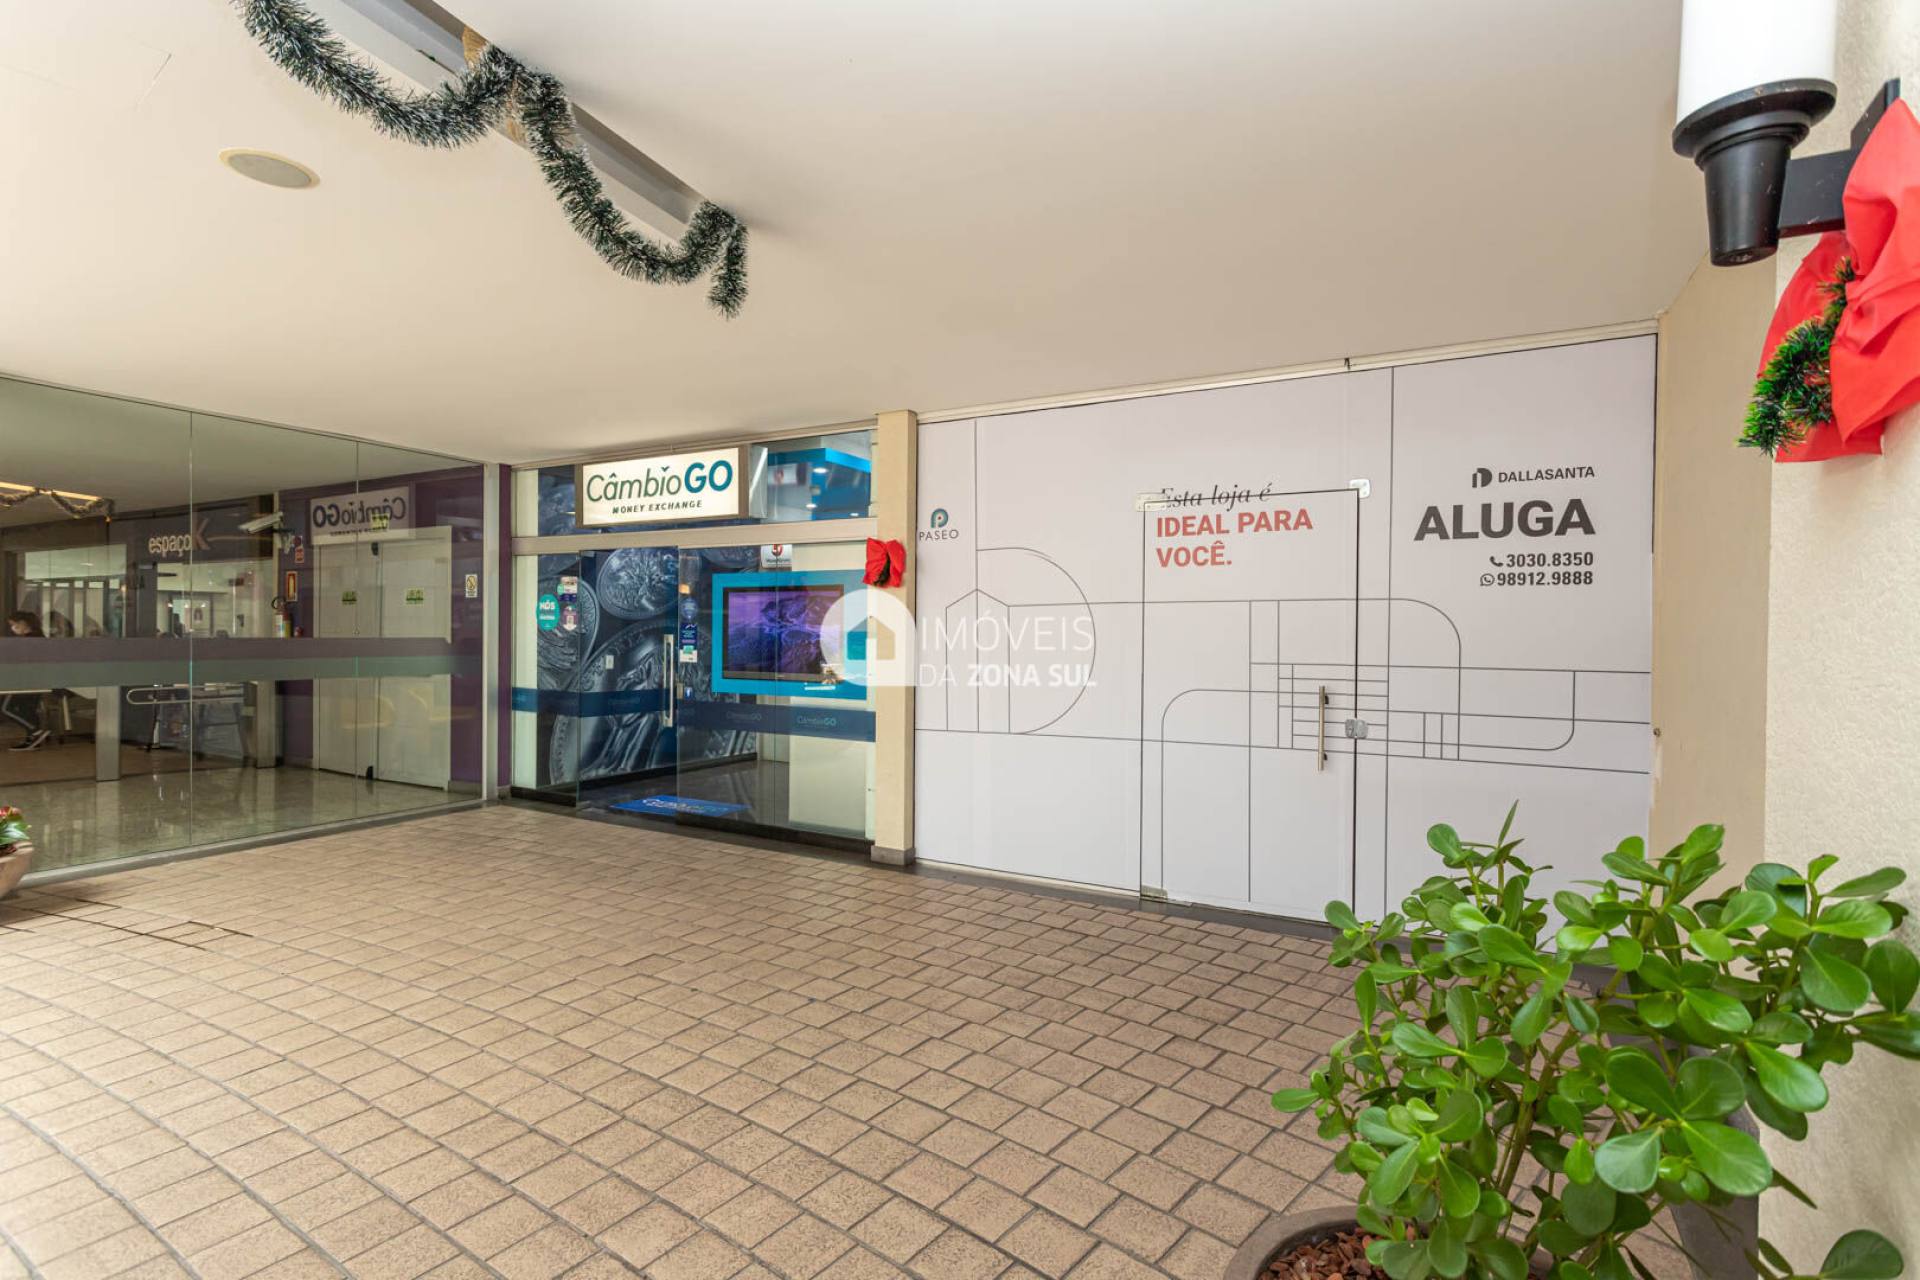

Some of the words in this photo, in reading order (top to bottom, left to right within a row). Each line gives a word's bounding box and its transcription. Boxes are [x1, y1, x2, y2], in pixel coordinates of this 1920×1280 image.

[1498, 466, 1595, 483] DALLASANTA
[1211, 484, 1251, 512] loja
[1259, 482, 1273, 501] é
[612, 504, 644, 514] MONEY
[648, 500, 702, 512] EXCHANGE
[1157, 513, 1230, 537] IDEAL
[1238, 508, 1313, 533] PARA
[1413, 498, 1596, 541] ALUGA
[919, 529, 959, 541] PASEO
[1156, 540, 1232, 568] VOCÊ.
[1506, 551, 1593, 568] 3030.8350
[1497, 571, 1593, 586] 98912.9888
